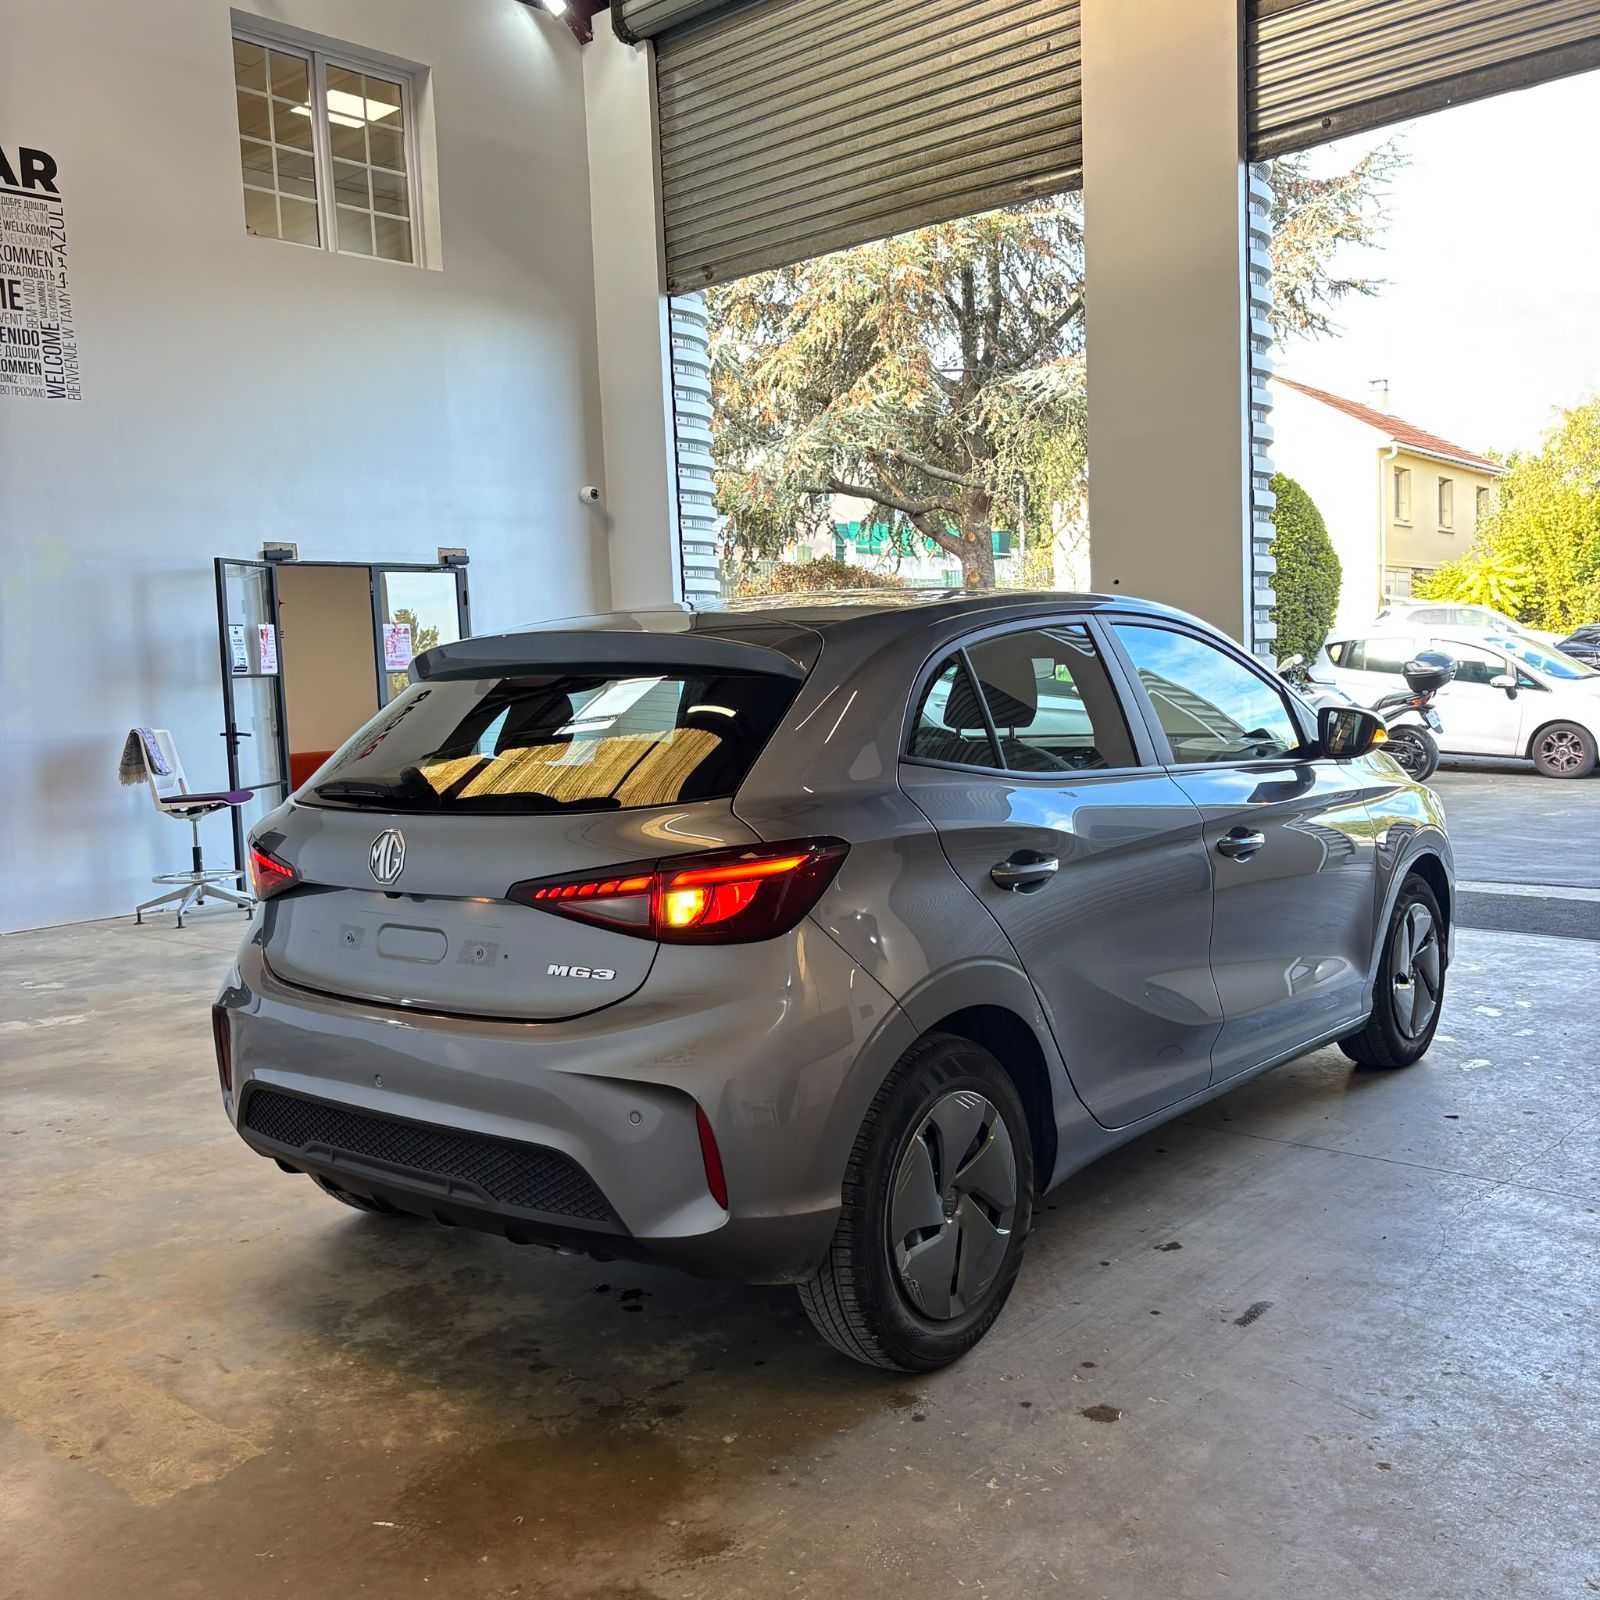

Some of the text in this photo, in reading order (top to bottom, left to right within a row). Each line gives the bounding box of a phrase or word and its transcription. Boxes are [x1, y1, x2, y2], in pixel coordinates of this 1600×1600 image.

[48, 207, 67, 256] AZUL
[0, 262, 55, 281] ОЖАЛОВАТЬ
[0, 359, 42, 376] OMMEN
[5, 345, 40, 360] ДОШЛИ
[40, 320, 66, 399] WELCOME
[62, 340, 81, 401] BIENVENUE
[370, 832, 404, 881] MG
[547, 963, 617, 981] MG3
